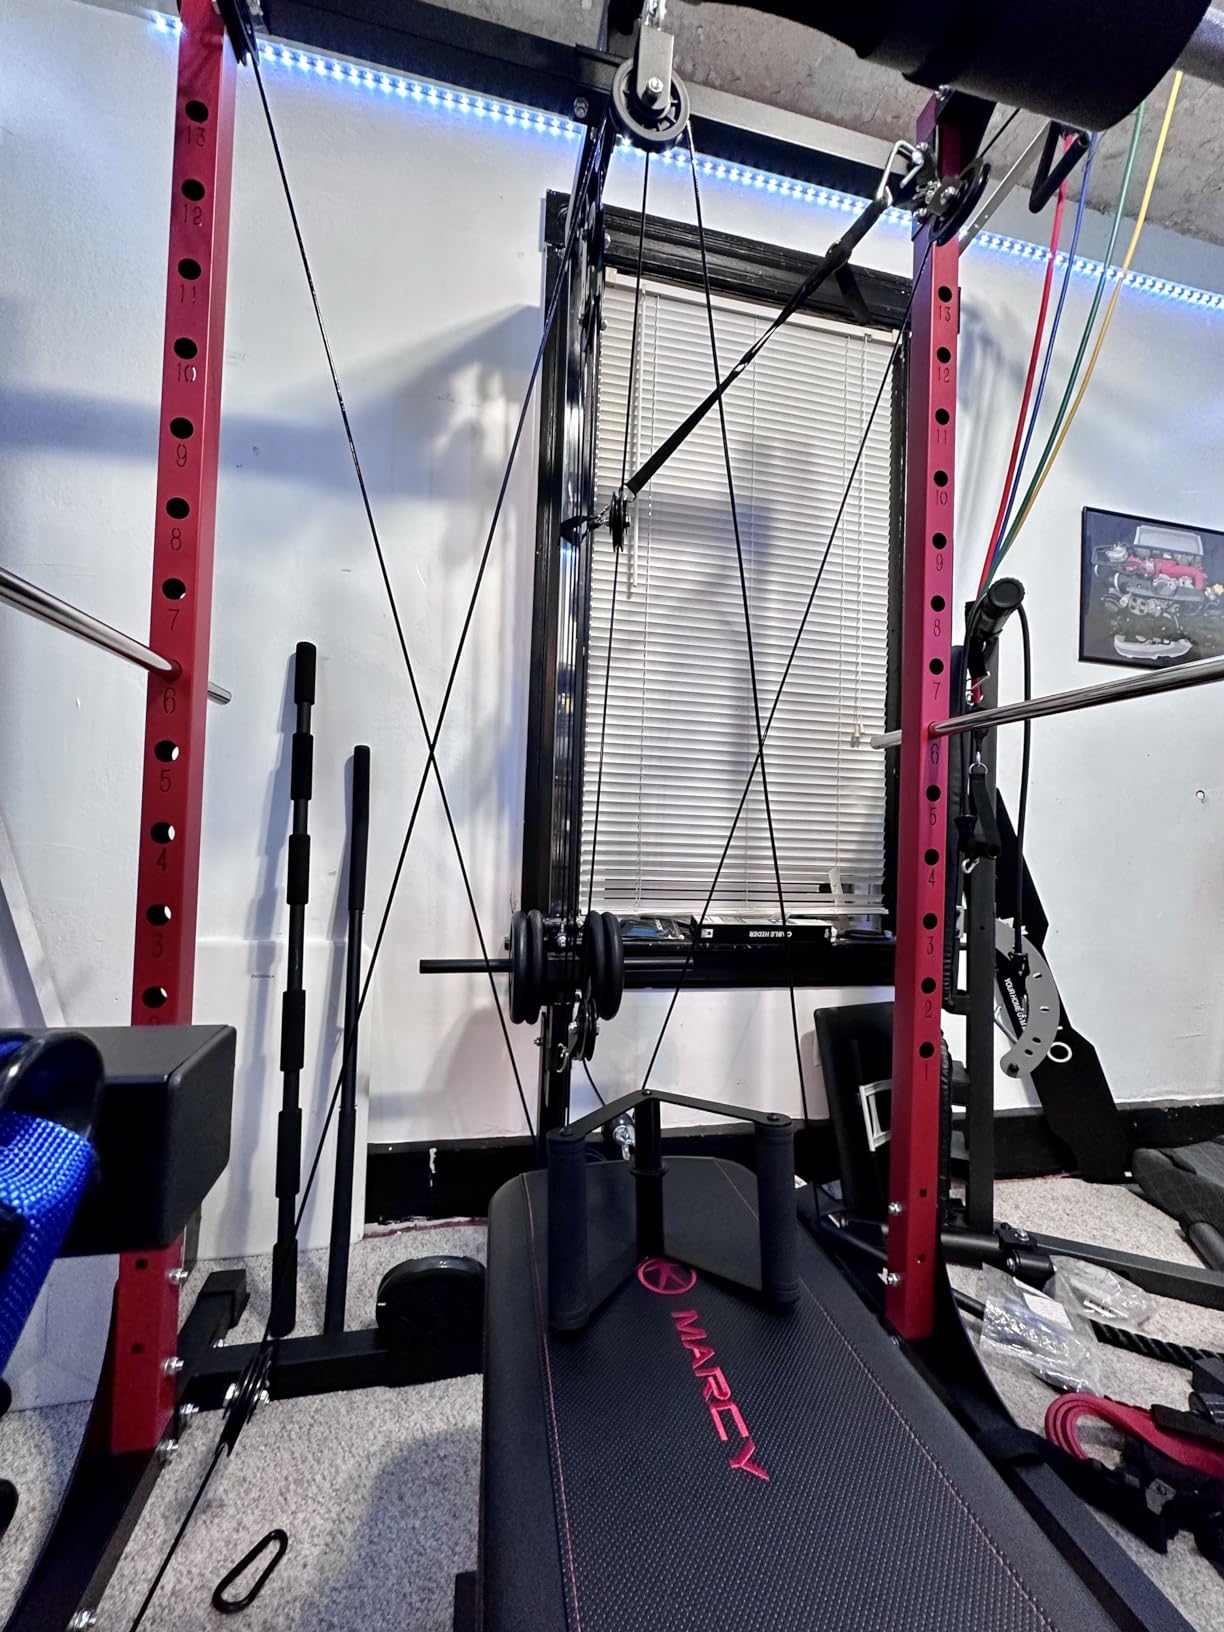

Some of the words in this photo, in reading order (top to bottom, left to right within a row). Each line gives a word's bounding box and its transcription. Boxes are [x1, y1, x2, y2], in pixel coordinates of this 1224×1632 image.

[186, 125, 206, 147] 13
[184, 204, 203, 226] 12
[938, 306, 951, 322] 13
[177, 362, 197, 382] 10
[937, 367, 950, 382] 12
[936, 429, 947, 445] 11
[176, 443, 187, 467] 9
[936, 490, 948, 505] 10
[170, 527, 181, 551] 8
[936, 553, 943, 571] 9
[168, 608, 180, 631] 7
[933, 618, 941, 637] 8
[163, 687, 176, 714] 6
[932, 682, 941, 700] 7
[930, 743, 939, 765] 6
[159, 769, 172, 793] 5
[929, 806, 937, 826] 5
[156, 848, 168, 871] 4
[928, 869, 936, 887] 4
[151, 933, 163, 958] 3
[926, 936, 934, 955] 3
[1004, 977, 1015, 995] YOUR
[924, 1000, 933, 1018] 2
[1009, 993, 1021, 1012] HOME
[671, 1310, 770, 1481] MARCY
